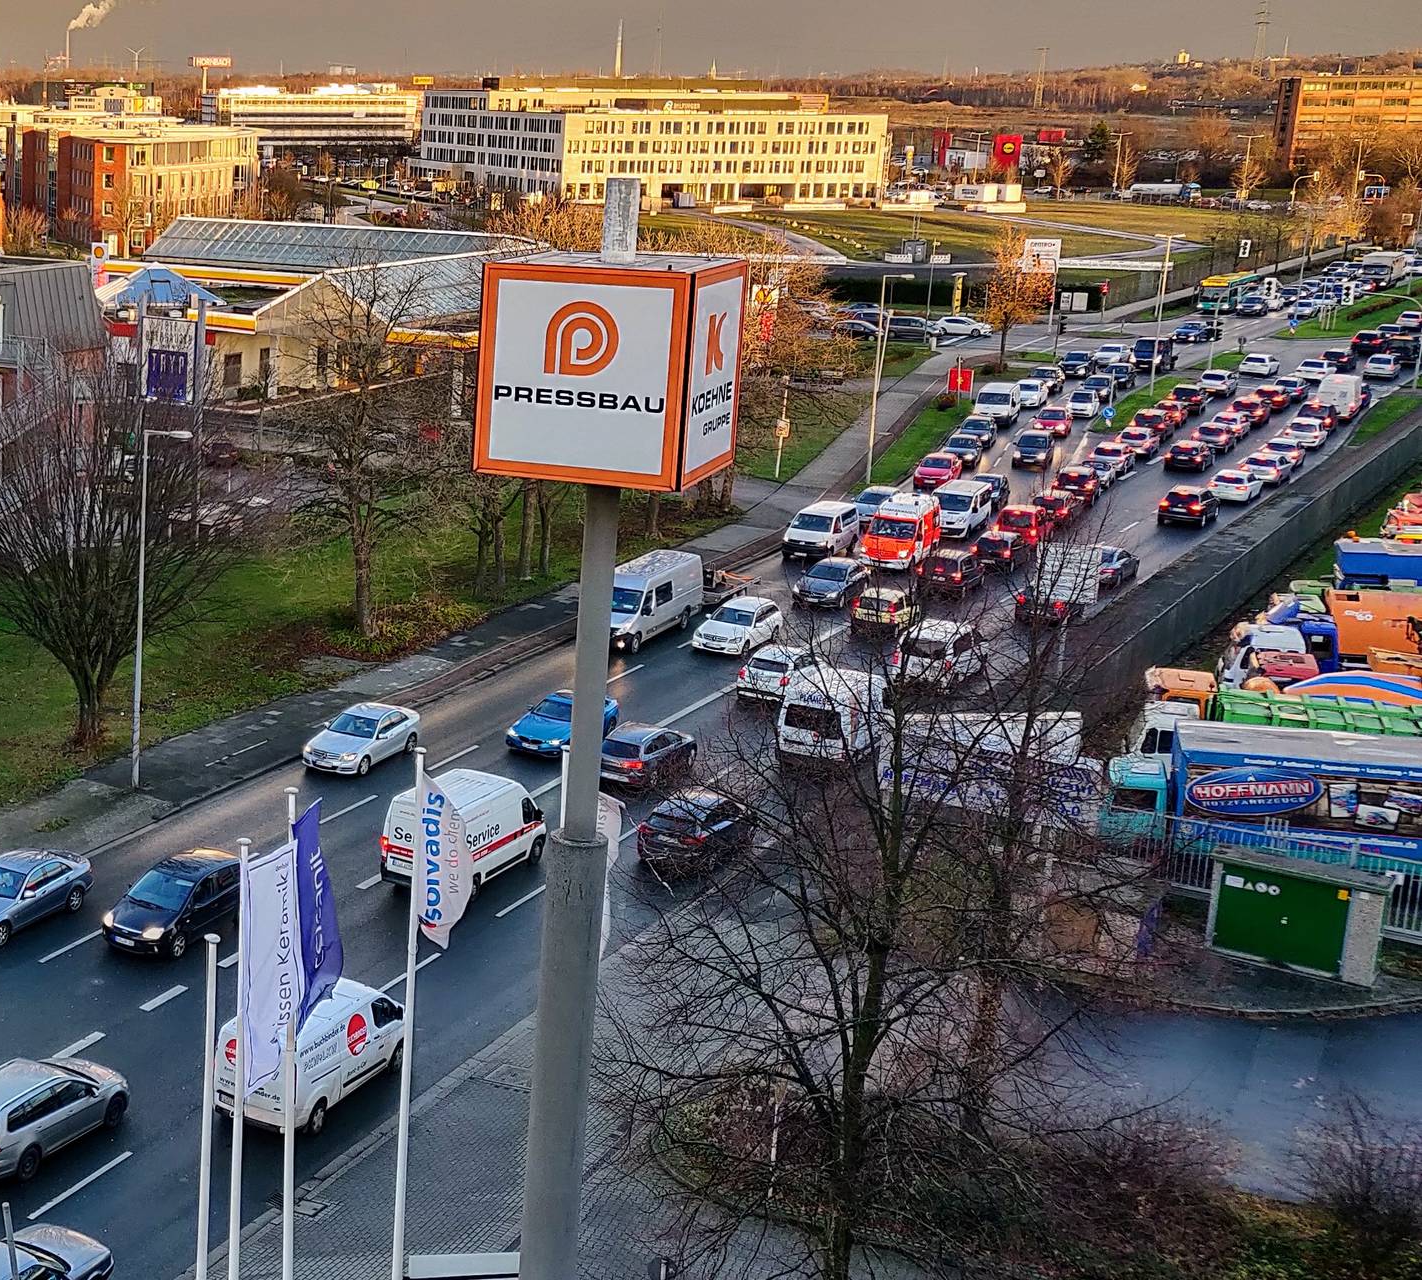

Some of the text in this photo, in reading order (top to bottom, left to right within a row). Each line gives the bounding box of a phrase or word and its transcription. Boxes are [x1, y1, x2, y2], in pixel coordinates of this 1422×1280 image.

[196, 56, 232, 67] HORNBACH
[493, 385, 665, 414] PRESSBAU
[691, 381, 733, 417] KOEHNE
[702, 412, 731, 437] GRUPPE
[1196, 782, 1310, 798] HOFFMANN
[1202, 796, 1307, 808] NUTZFAHRZEUGE
[466, 823, 500, 850] Service
[444, 850, 459, 869] do
[449, 873, 459, 895] we
[277, 874, 292, 968] Keramik
[299, 1023, 346, 1058] www.buchbinder.de
